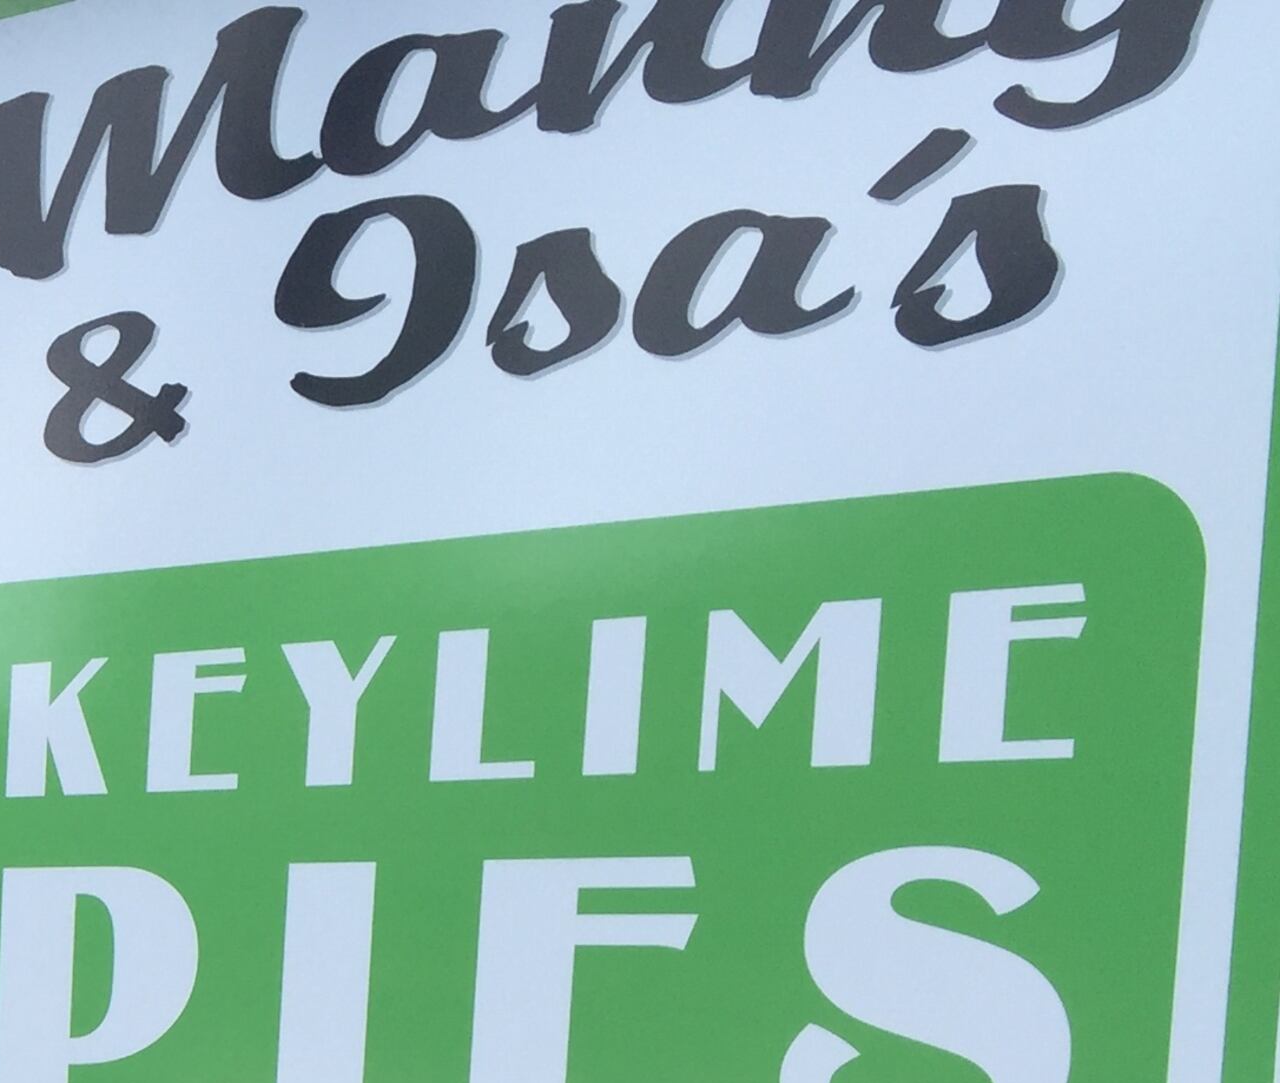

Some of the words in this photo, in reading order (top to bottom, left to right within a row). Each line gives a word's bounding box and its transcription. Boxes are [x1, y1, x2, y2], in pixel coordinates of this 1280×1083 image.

[44, 311, 190, 464] &
[275, 128, 1062, 410] Isa's
[5, 583, 1087, 798] KEYLIME
